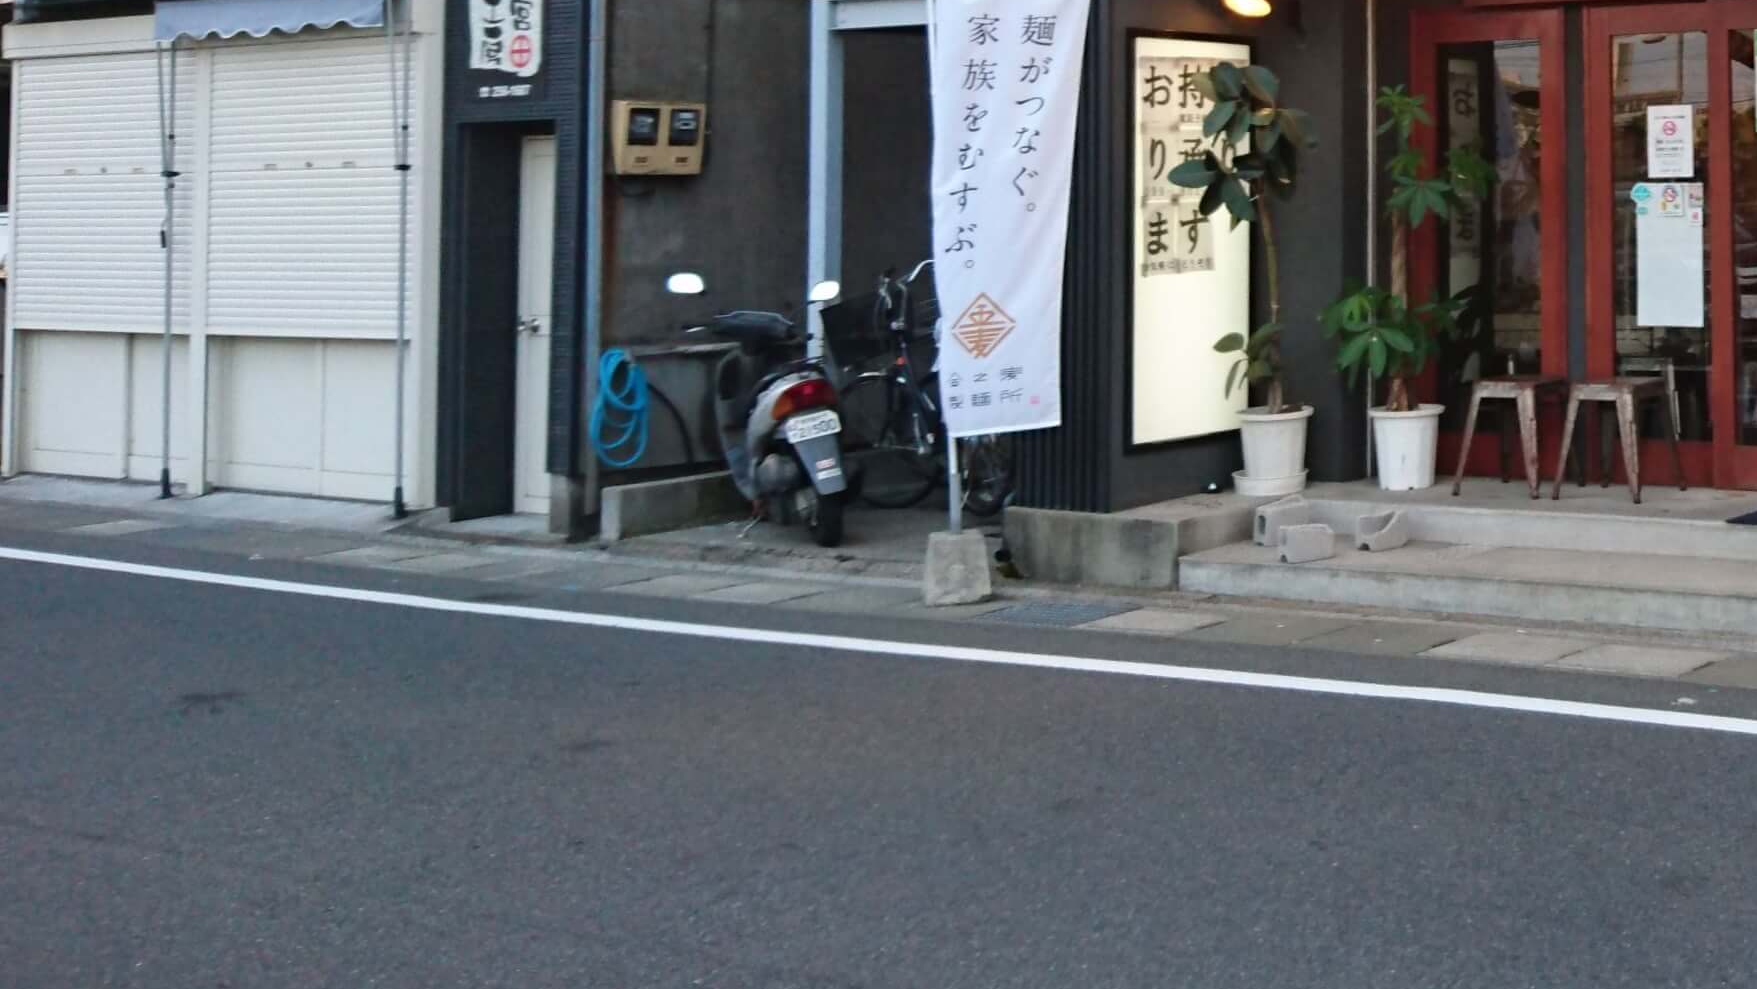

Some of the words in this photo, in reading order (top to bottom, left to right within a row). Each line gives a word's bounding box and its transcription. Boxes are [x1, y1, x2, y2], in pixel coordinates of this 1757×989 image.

[945, 13, 1000, 269] 家族をむすぶ。
[1012, 14, 1057, 212] 麺がつなぐ。
[1142, 63, 1205, 109] お持
[1147, 209, 1210, 255] ます
